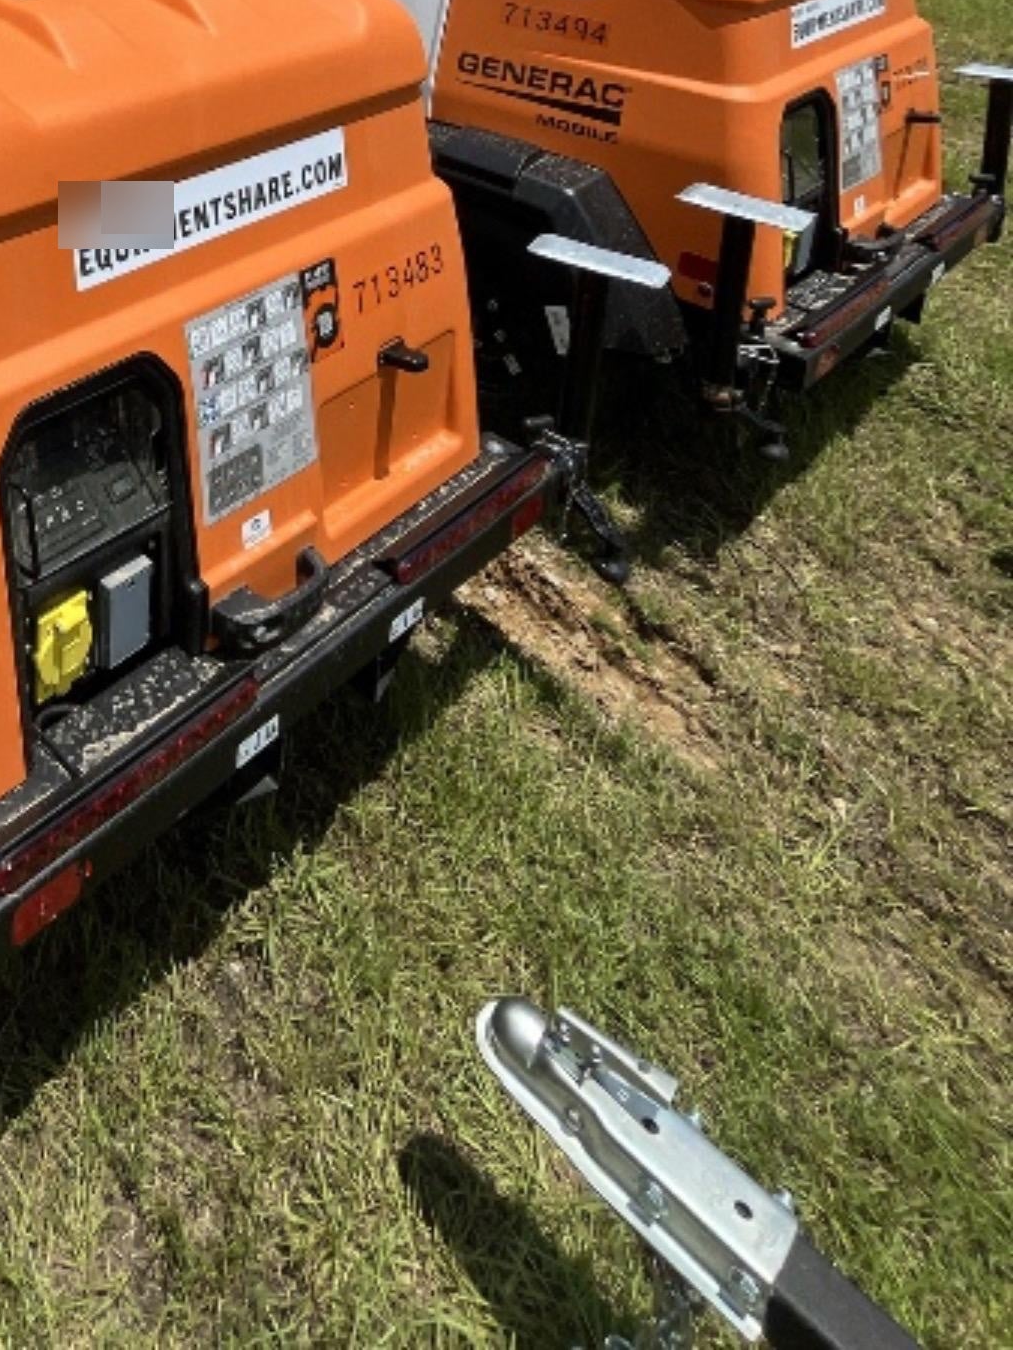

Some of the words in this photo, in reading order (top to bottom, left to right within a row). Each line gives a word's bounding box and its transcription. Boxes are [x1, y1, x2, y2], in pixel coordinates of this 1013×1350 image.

[502, 2, 611, 46] 713494
[457, 52, 626, 108] GENERAC
[535, 113, 620, 145] MOBILE
[78, 152, 343, 278] EQENTSHARE.COM
[352, 241, 444, 315] 713483
